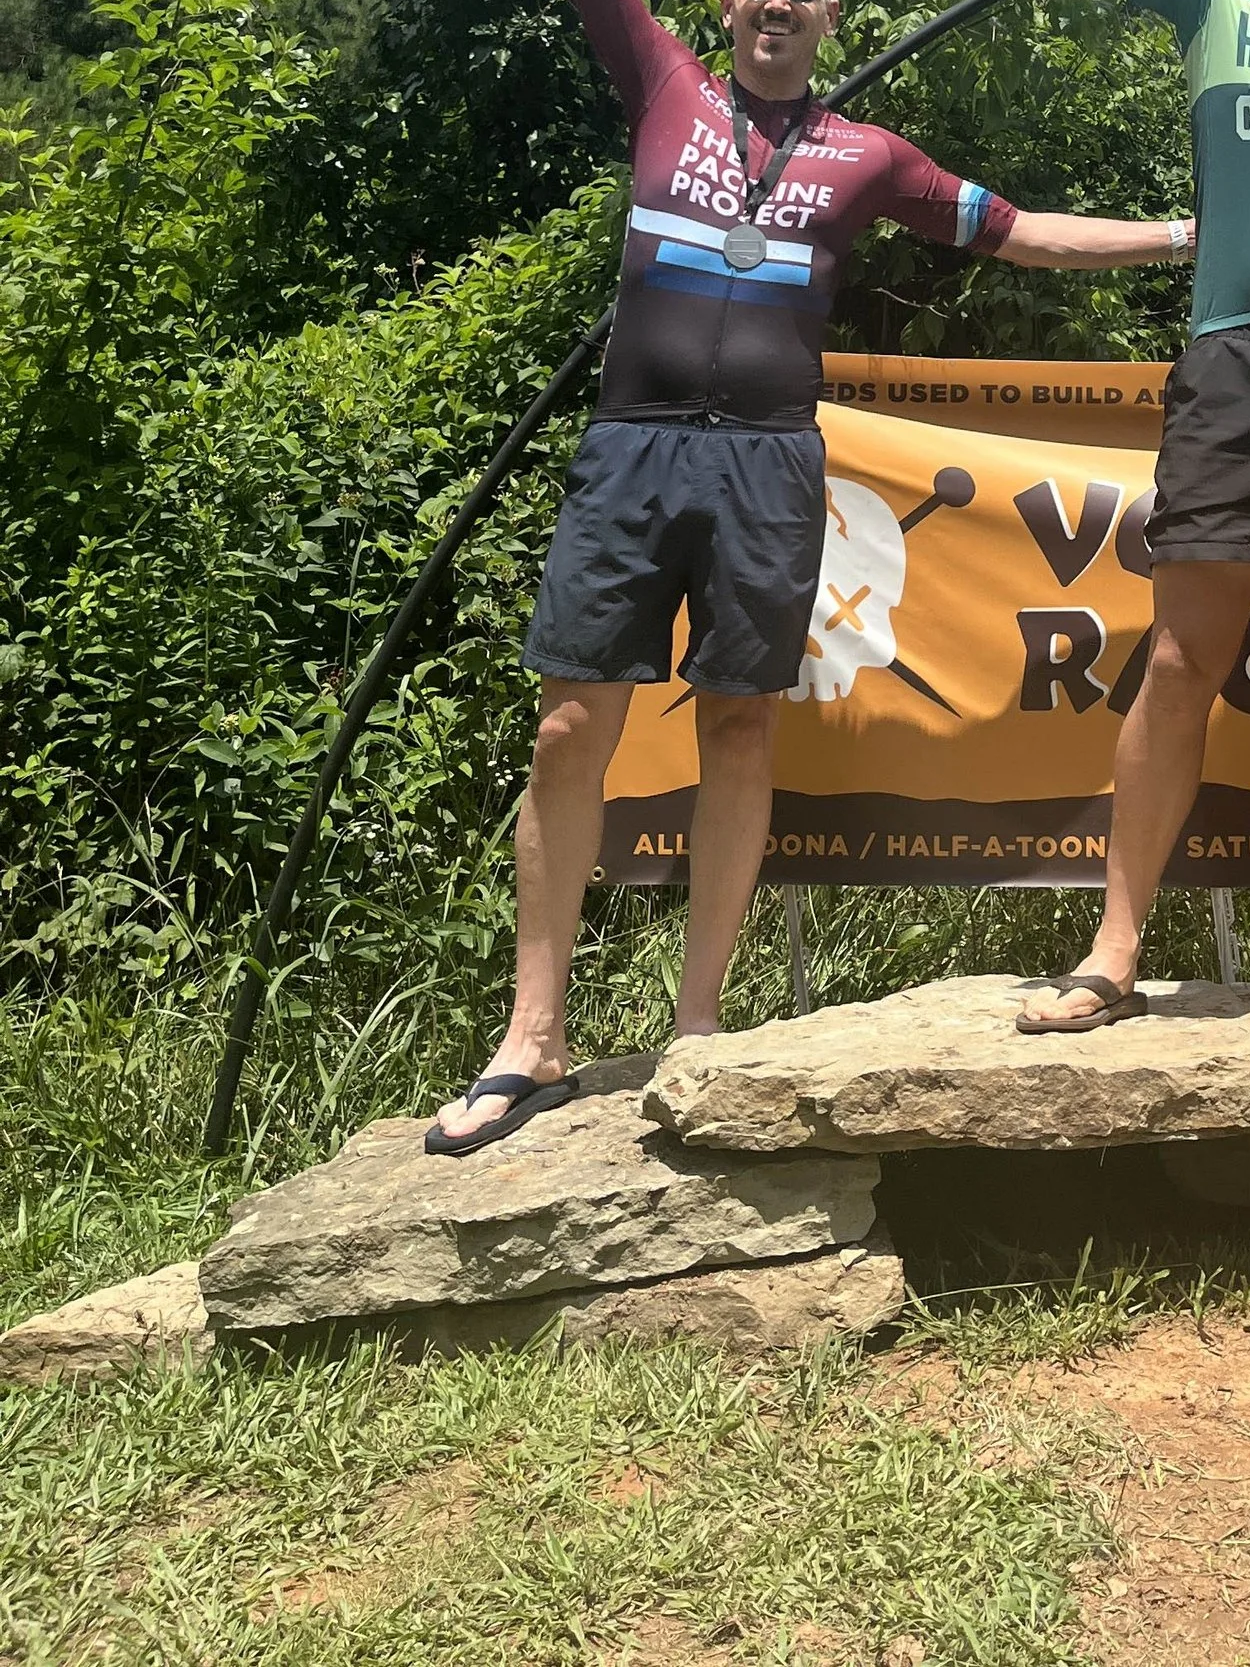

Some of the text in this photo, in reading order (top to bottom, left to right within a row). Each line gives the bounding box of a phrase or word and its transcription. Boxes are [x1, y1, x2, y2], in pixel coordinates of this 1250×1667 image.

[691, 118, 741, 169] THE
[678, 143, 834, 208] PACINE
[888, 383, 970, 404] USED
[980, 384, 1021, 405] TO
[1032, 385, 1123, 405] BUILD
[633, 832, 849, 857] ALLOONA
[887, 834, 1106, 858] HALF-A-TOON
